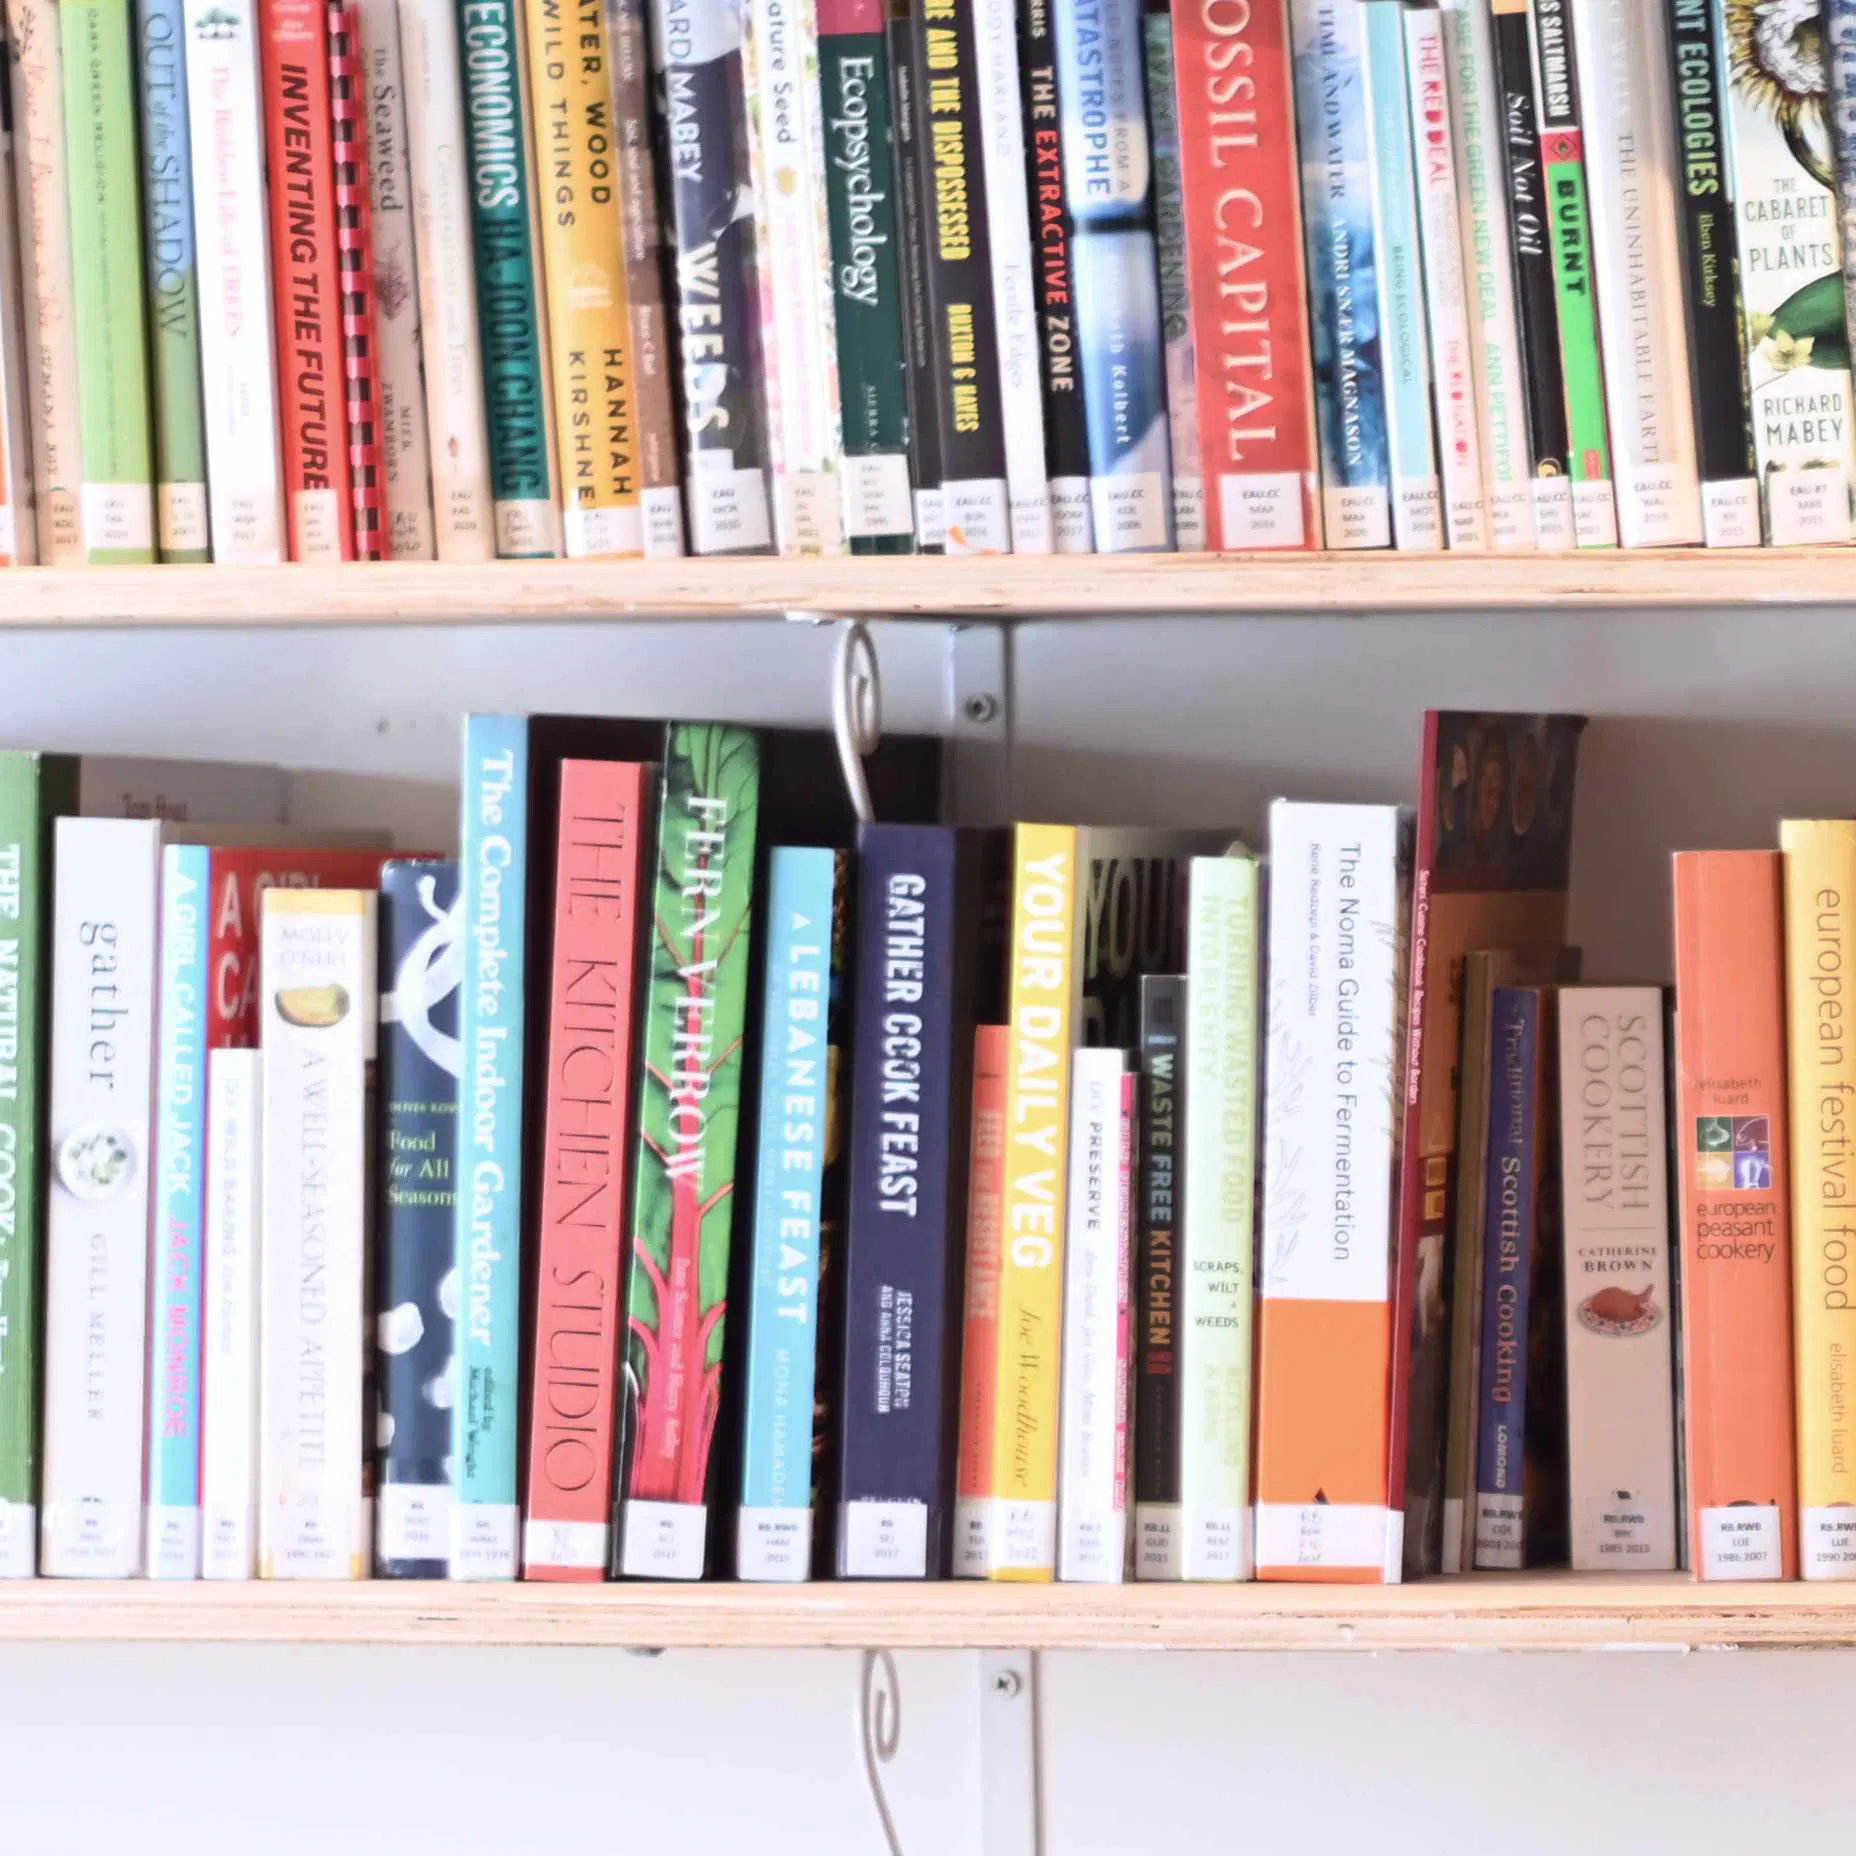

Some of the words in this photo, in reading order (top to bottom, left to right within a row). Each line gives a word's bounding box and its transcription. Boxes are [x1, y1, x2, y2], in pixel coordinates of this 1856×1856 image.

[463, 2, 520, 209] ECONOMICS
[667, 72, 703, 184] MABEY
[1031, 66, 1056, 119] THE
[1505, 91, 1534, 149] Soil
[1676, 43, 1720, 198] ECOLOGIES
[281, 63, 318, 263] INVENTING
[585, 102, 611, 205] WOOD
[831, 55, 889, 308] Ecopsychology
[1512, 156, 1539, 205] Not
[1744, 195, 1830, 222] CABARET
[1773, 178, 1798, 193] THE
[1034, 130, 1069, 306] EXTRACTIVE
[1515, 213, 1543, 257] Oil
[1555, 180, 1588, 296] BURNT
[1749, 243, 1833, 272] PLANTS
[1781, 225, 1796, 240] OF
[292, 273, 322, 343] THE
[678, 241, 731, 434] WEEDS
[1046, 315, 1075, 394] ZONE
[1212, 187, 1278, 461] CAPITAL
[295, 348, 330, 490] FUTURE
[604, 349, 632, 496] HANNAH
[1763, 392, 1843, 415] RICHARD
[1766, 420, 1844, 445] MABEY
[480, 749, 514, 838] The
[566, 804, 626, 921] THE
[1338, 842, 1363, 890] The
[471, 843, 512, 1017] Complete
[882, 873, 927, 1003] GATHER
[1020, 853, 1068, 993] YOUR
[1338, 897, 1361, 968] Noma
[1809, 888, 1844, 1068] european
[79, 920, 129, 1091] gather
[781, 943, 821, 1172] LEBANESE
[1336, 978, 1360, 1051] Guide
[471, 1027, 509, 1152] Indoor
[554, 956, 624, 1227] KITCHEN
[1012, 1004, 1064, 1159] DAILY
[1335, 1060, 1358, 1084] to
[878, 1112, 920, 1219] FEAST
[1009, 1169, 1059, 1271] VEG
[1332, 1093, 1358, 1261] Fermentation
[164, 1217, 191, 1303] JACK
[468, 1164, 505, 1347] Gardener
[775, 1188, 815, 1325] FEAST
[162, 1305, 191, 1439] MONROE
[543, 1265, 604, 1492] STUDIO
[1194, 1315, 1240, 1330] WEEDS
